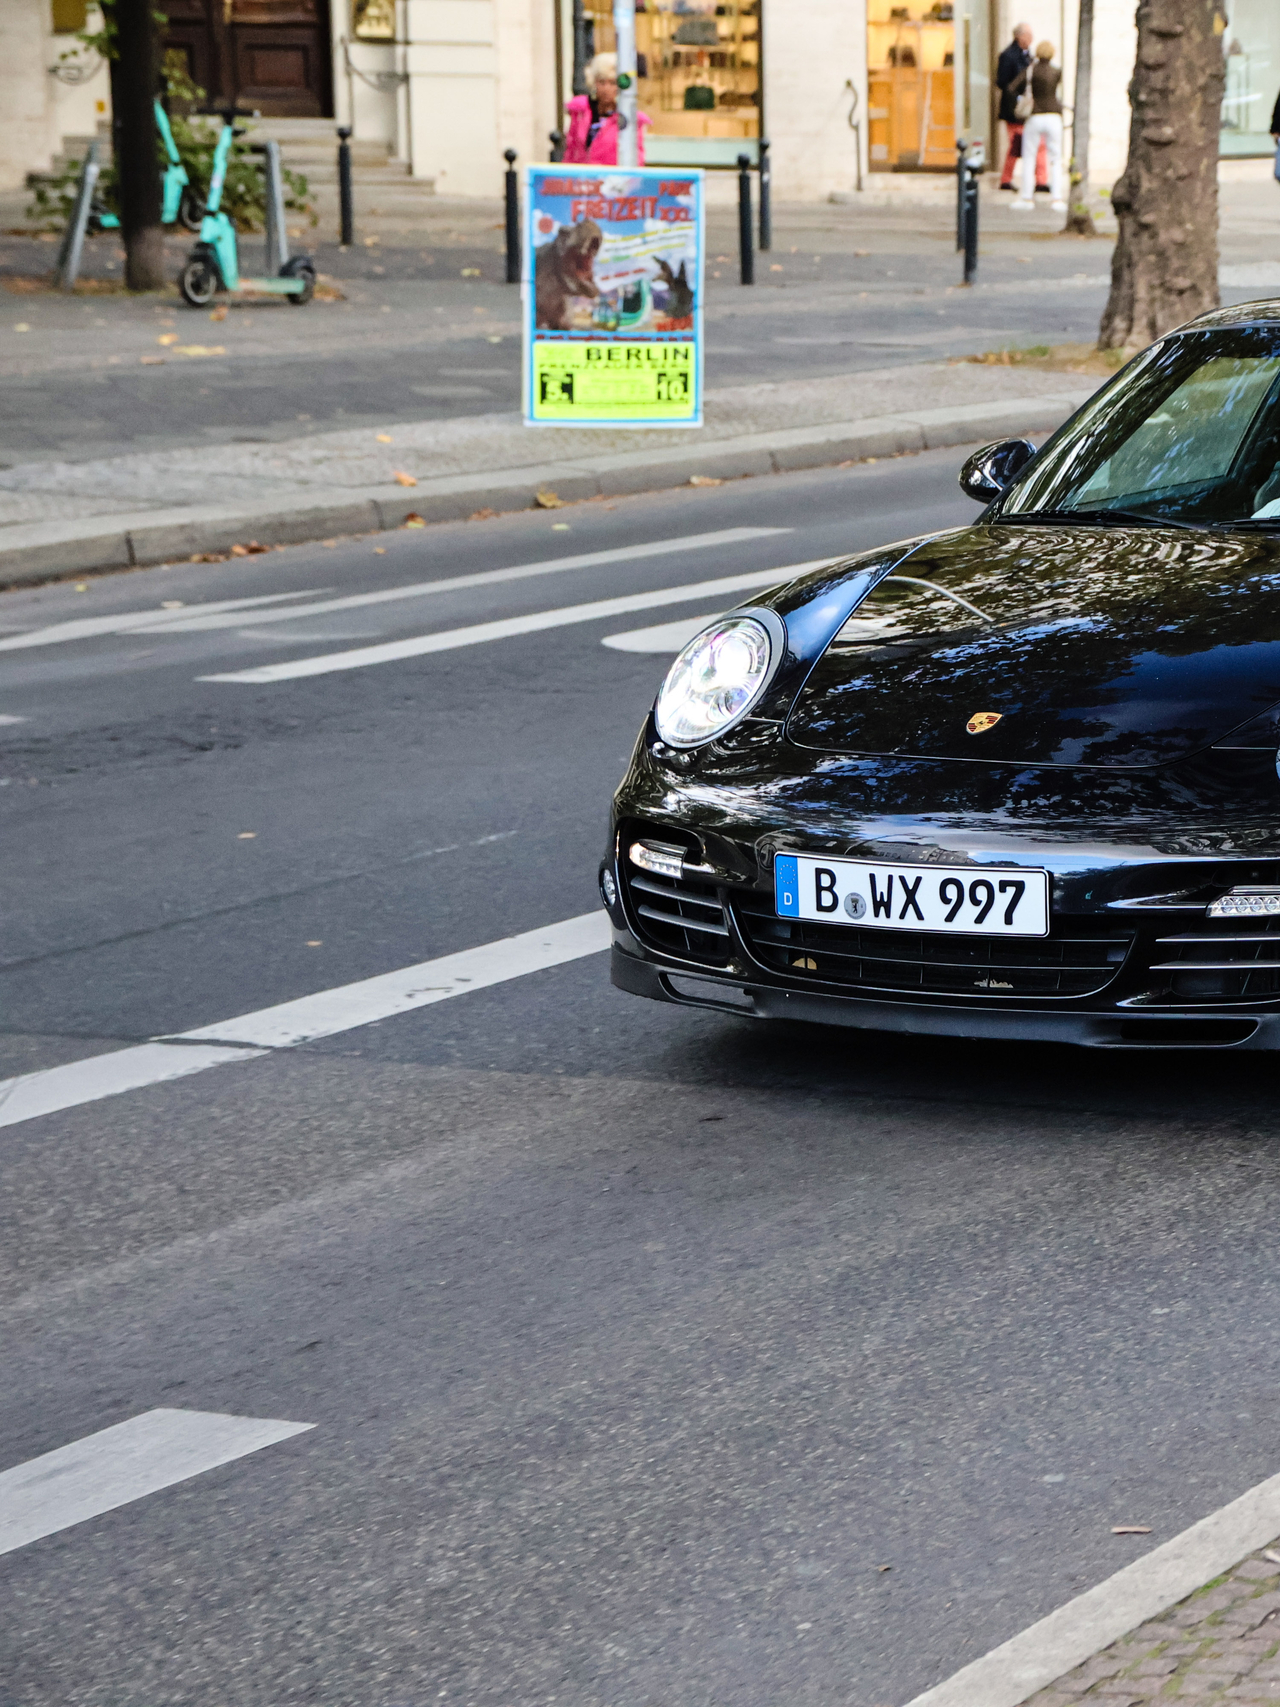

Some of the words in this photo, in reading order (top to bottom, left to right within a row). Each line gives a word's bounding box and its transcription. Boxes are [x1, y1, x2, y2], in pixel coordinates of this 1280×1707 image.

[571, 196, 658, 221] FREIZEIT
[659, 206, 694, 221] XXL
[586, 347, 689, 361] BERLIN
[783, 891, 793, 906] D
[814, 867, 839, 913] B
[869, 872, 925, 921] WX
[939, 877, 1026, 926] 997
